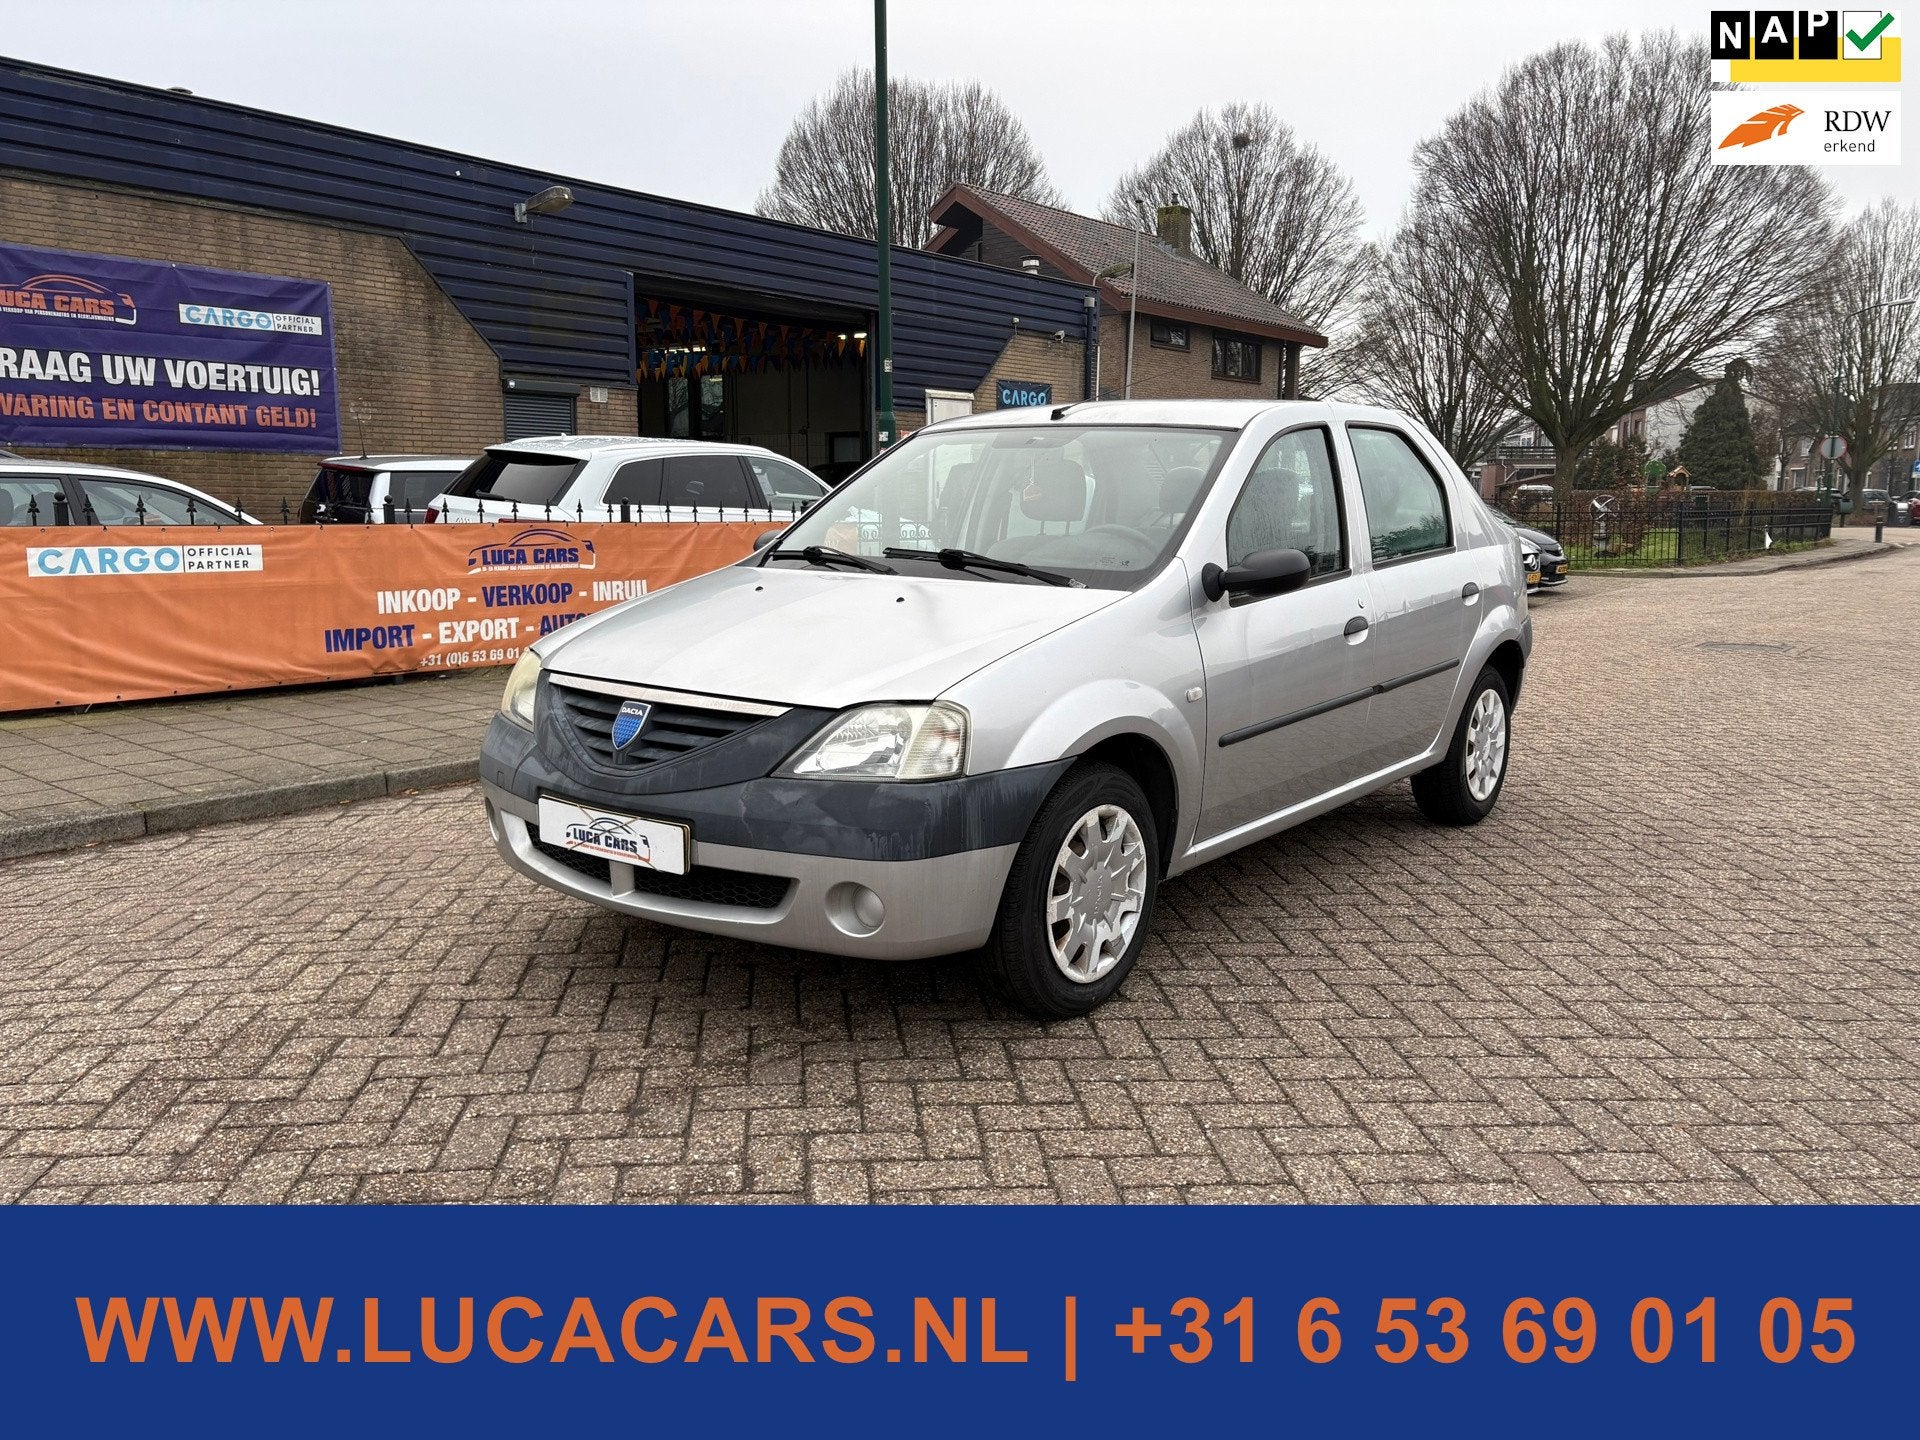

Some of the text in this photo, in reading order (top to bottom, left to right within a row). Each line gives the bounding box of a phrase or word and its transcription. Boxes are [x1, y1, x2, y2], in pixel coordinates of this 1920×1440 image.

[54, 295, 115, 316] CARS
[185, 305, 273, 329] CARGO
[275, 315, 316, 325] OFFICIAL
[277, 323, 315, 333] PARTNER
[102, 354, 156, 387] UW
[164, 359, 320, 396] VOERTUIG!
[1003, 389, 1046, 407] CARGO
[102, 397, 136, 421] EN
[143, 400, 248, 426] CONTANT
[255, 406, 317, 429] GELD!
[37, 548, 180, 574] CARGO
[187, 547, 252, 557] OFFICIAL
[481, 548, 579, 565] LUCA CARS
[188, 559, 250, 570] PARTNER
[376, 587, 461, 615] INKOOP
[481, 582, 574, 608] VERKOOP
[324, 624, 415, 653] IMPORT
[438, 617, 519, 645] EXPORT
[420, 653, 441, 667] +31
[446, 651, 469, 667] (0)6
[472, 650, 487, 662] 53
[489, 648, 504, 661] 69
[506, 647, 520, 660] 01
[622, 707, 643, 716] DACIA
[573, 828, 601, 845] LUCA
[604, 835, 637, 854] CARS
